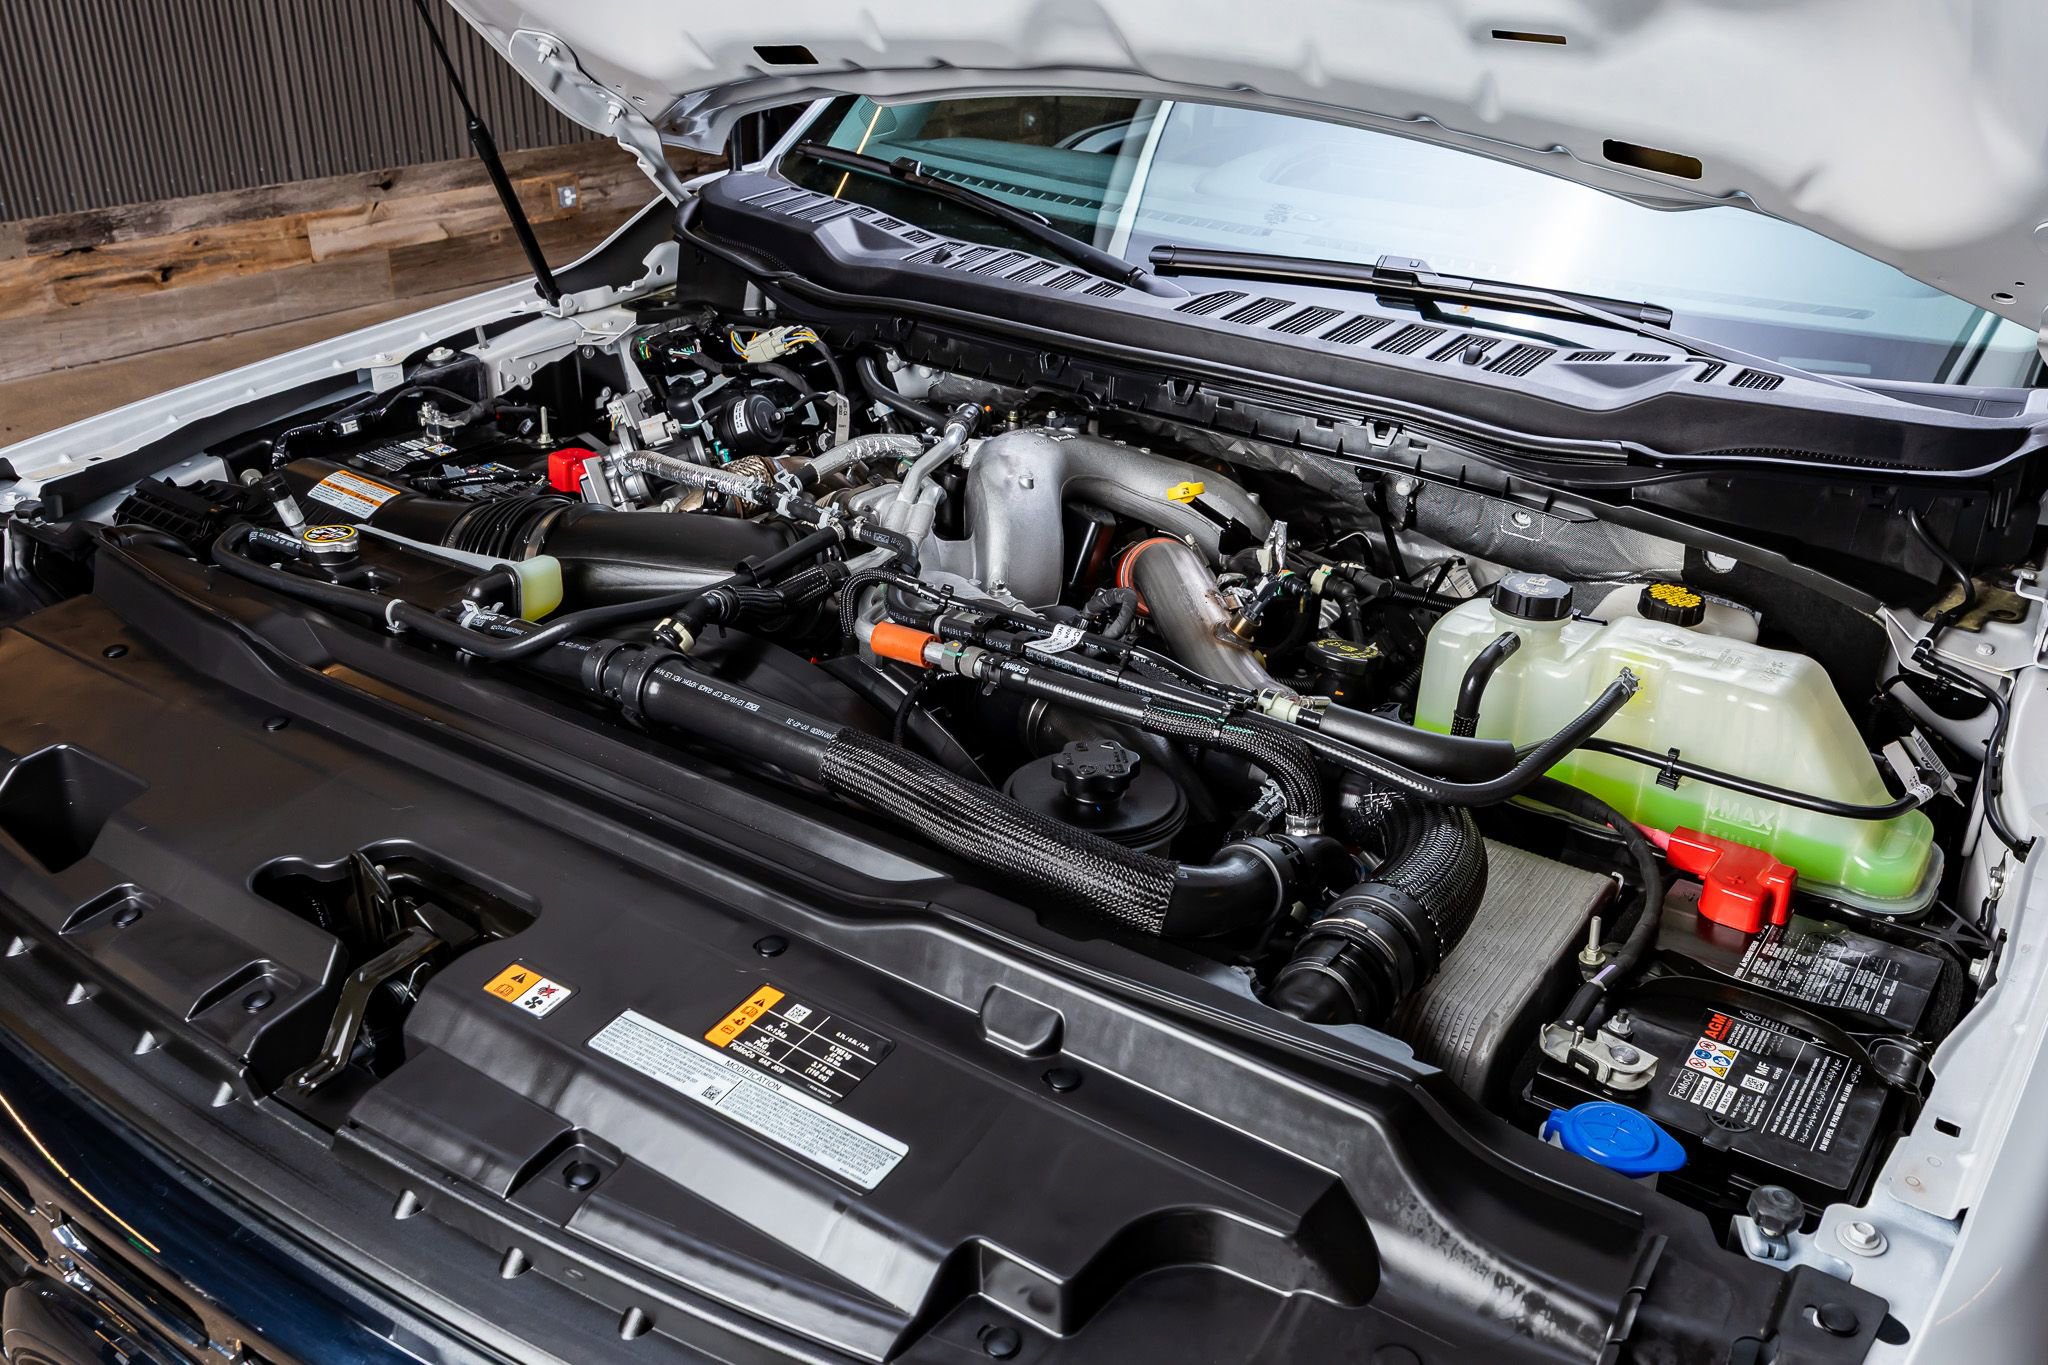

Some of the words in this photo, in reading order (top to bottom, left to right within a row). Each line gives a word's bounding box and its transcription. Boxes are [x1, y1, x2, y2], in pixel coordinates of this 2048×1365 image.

[1719, 801, 1775, 831] MAX
[765, 1025, 787, 1038] R-134a
[1705, 1014, 1727, 1038] AGM
[729, 1043, 755, 1059] FoMoCo
[753, 1039, 769, 1050] PAG
[725, 1060, 782, 1092] MODIFICATION
[1755, 1061, 1770, 1076] MF
[1673, 1069, 1695, 1099] FoMoCo
